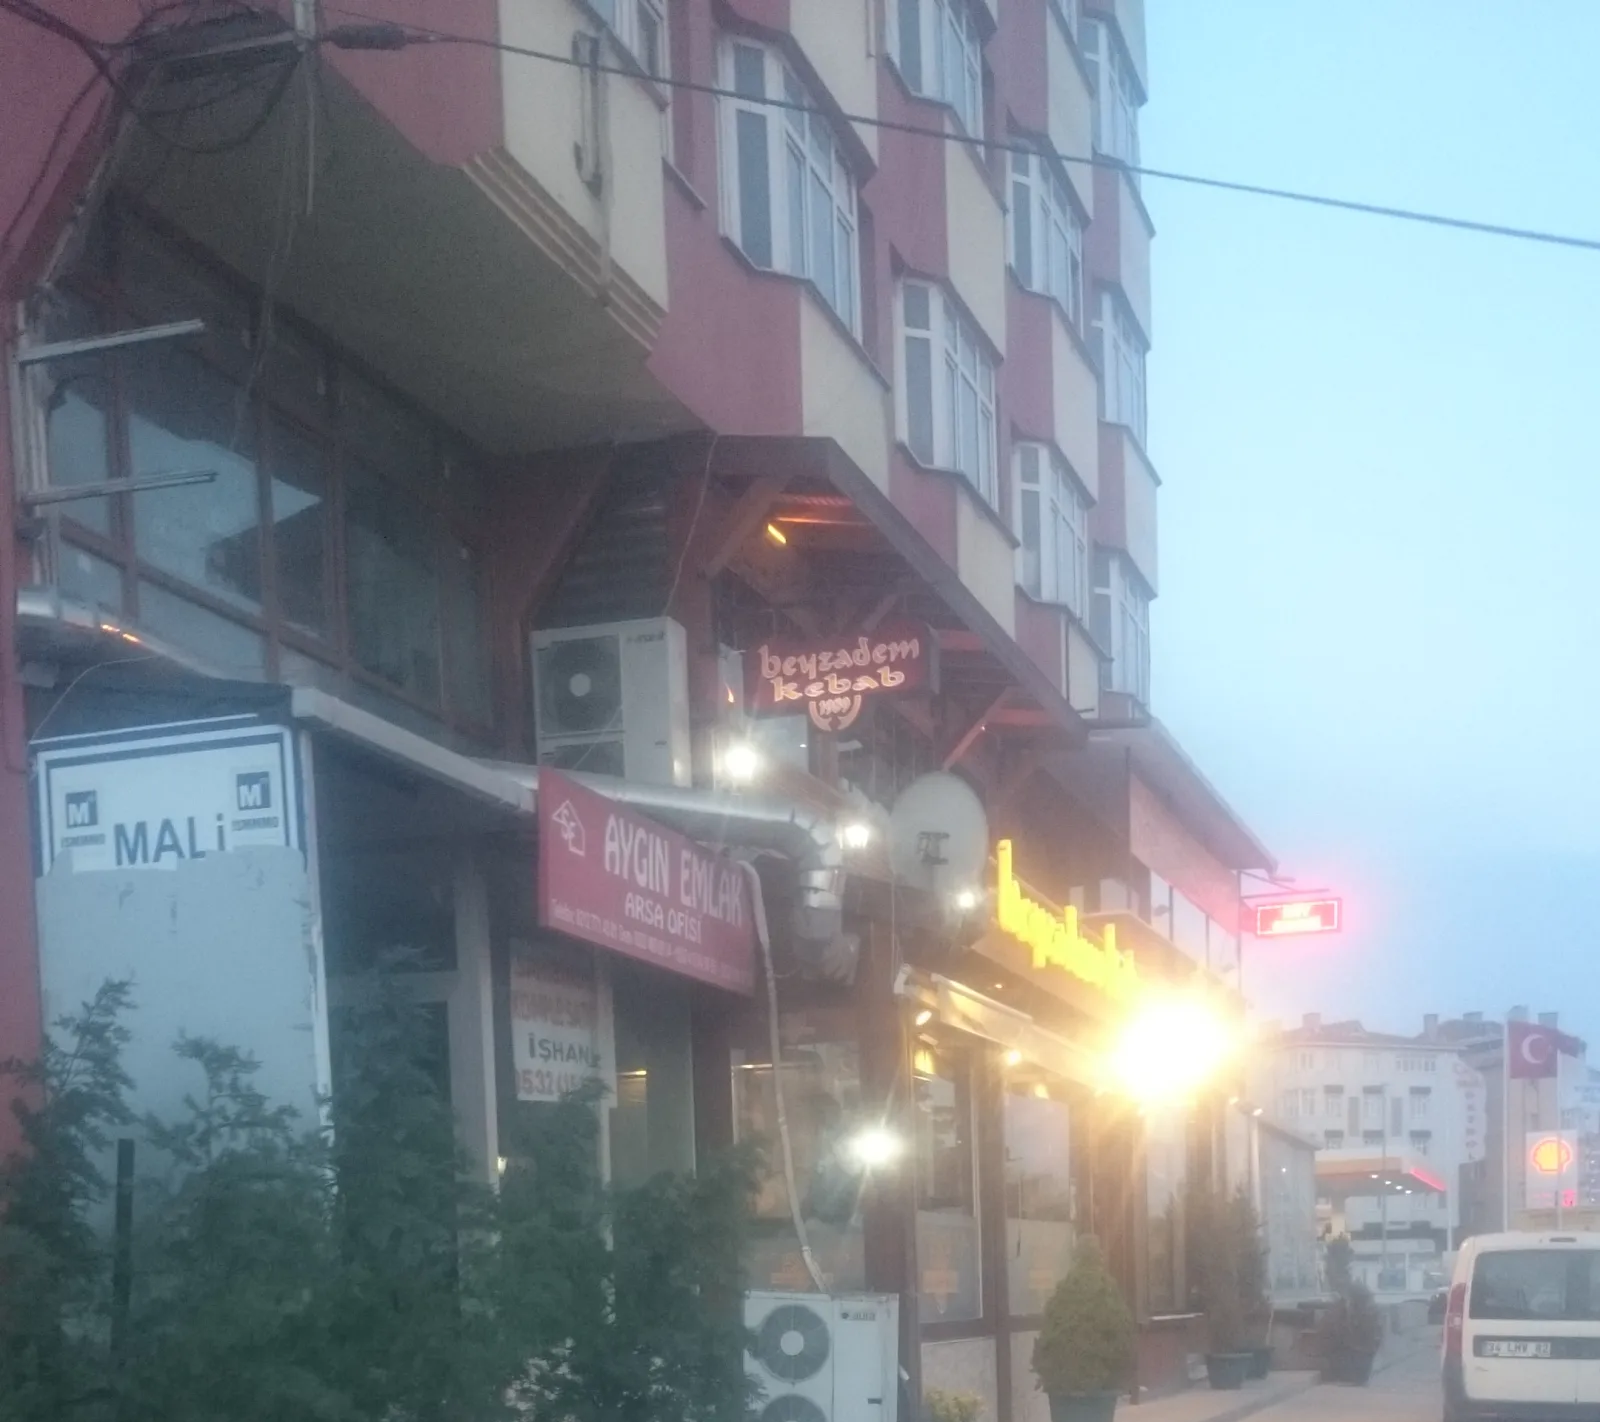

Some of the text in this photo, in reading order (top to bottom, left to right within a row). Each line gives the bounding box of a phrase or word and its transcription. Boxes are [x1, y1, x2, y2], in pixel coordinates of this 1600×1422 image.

[758, 637, 920, 679] beyzadem
[770, 666, 906, 702] kebab
[604, 813, 743, 929] AYGIN EMLAK
[625, 891, 665, 931] ARSA
